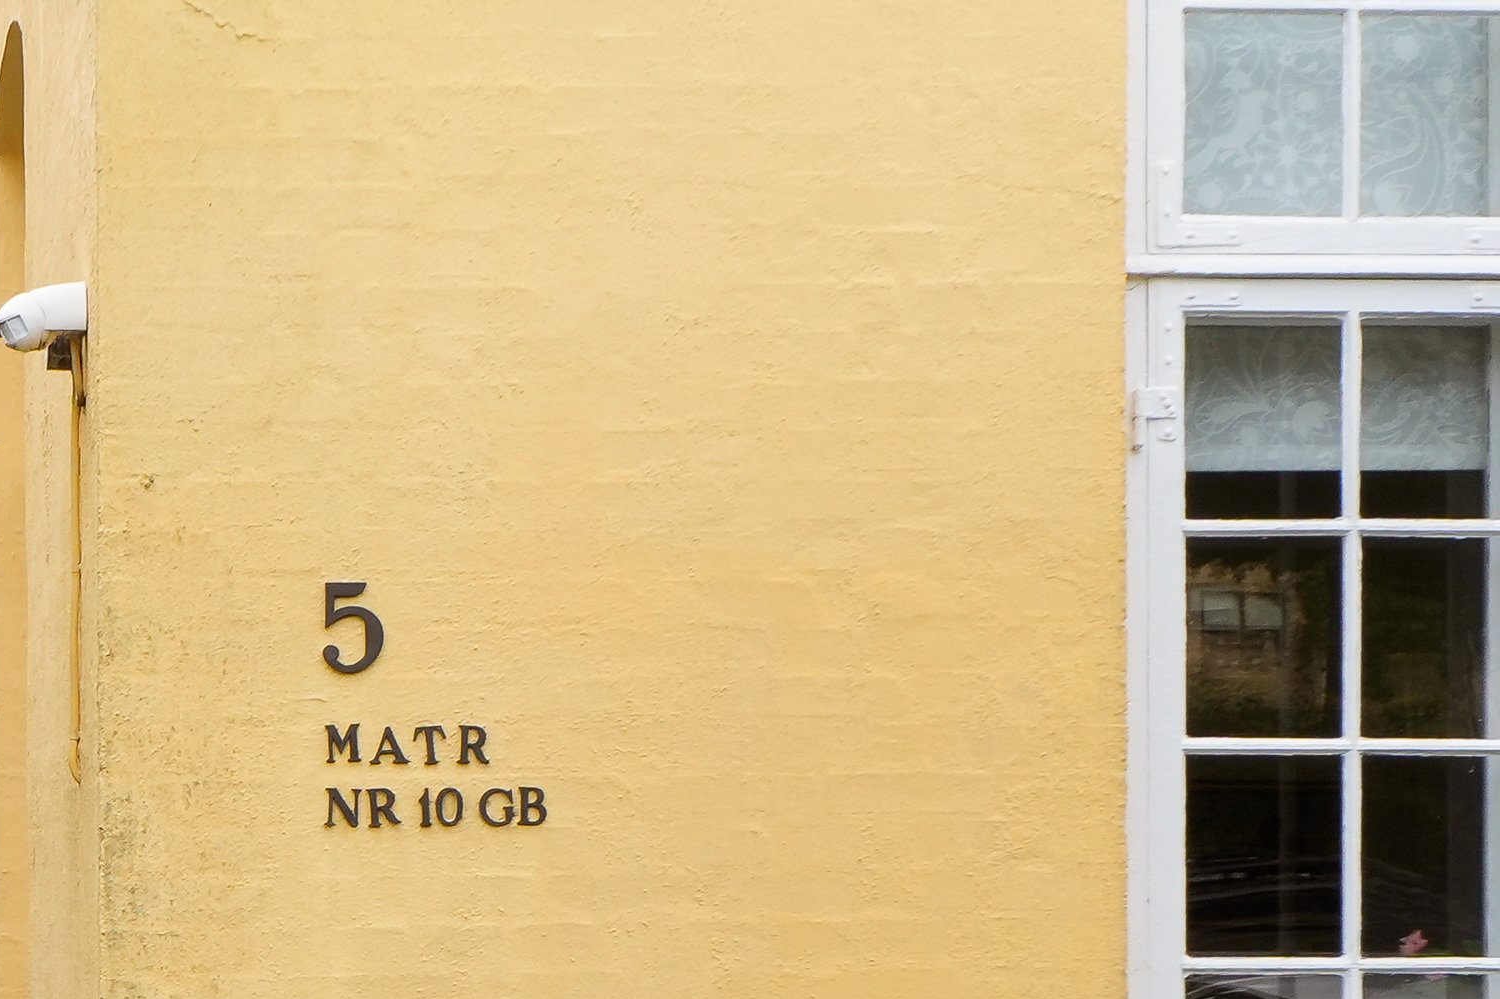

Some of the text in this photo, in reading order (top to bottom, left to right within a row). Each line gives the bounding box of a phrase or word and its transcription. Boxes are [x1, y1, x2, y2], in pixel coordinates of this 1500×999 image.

[322, 582, 384, 676] 5
[324, 723, 490, 767] MATR
[323, 786, 548, 829] NR 10 GB
